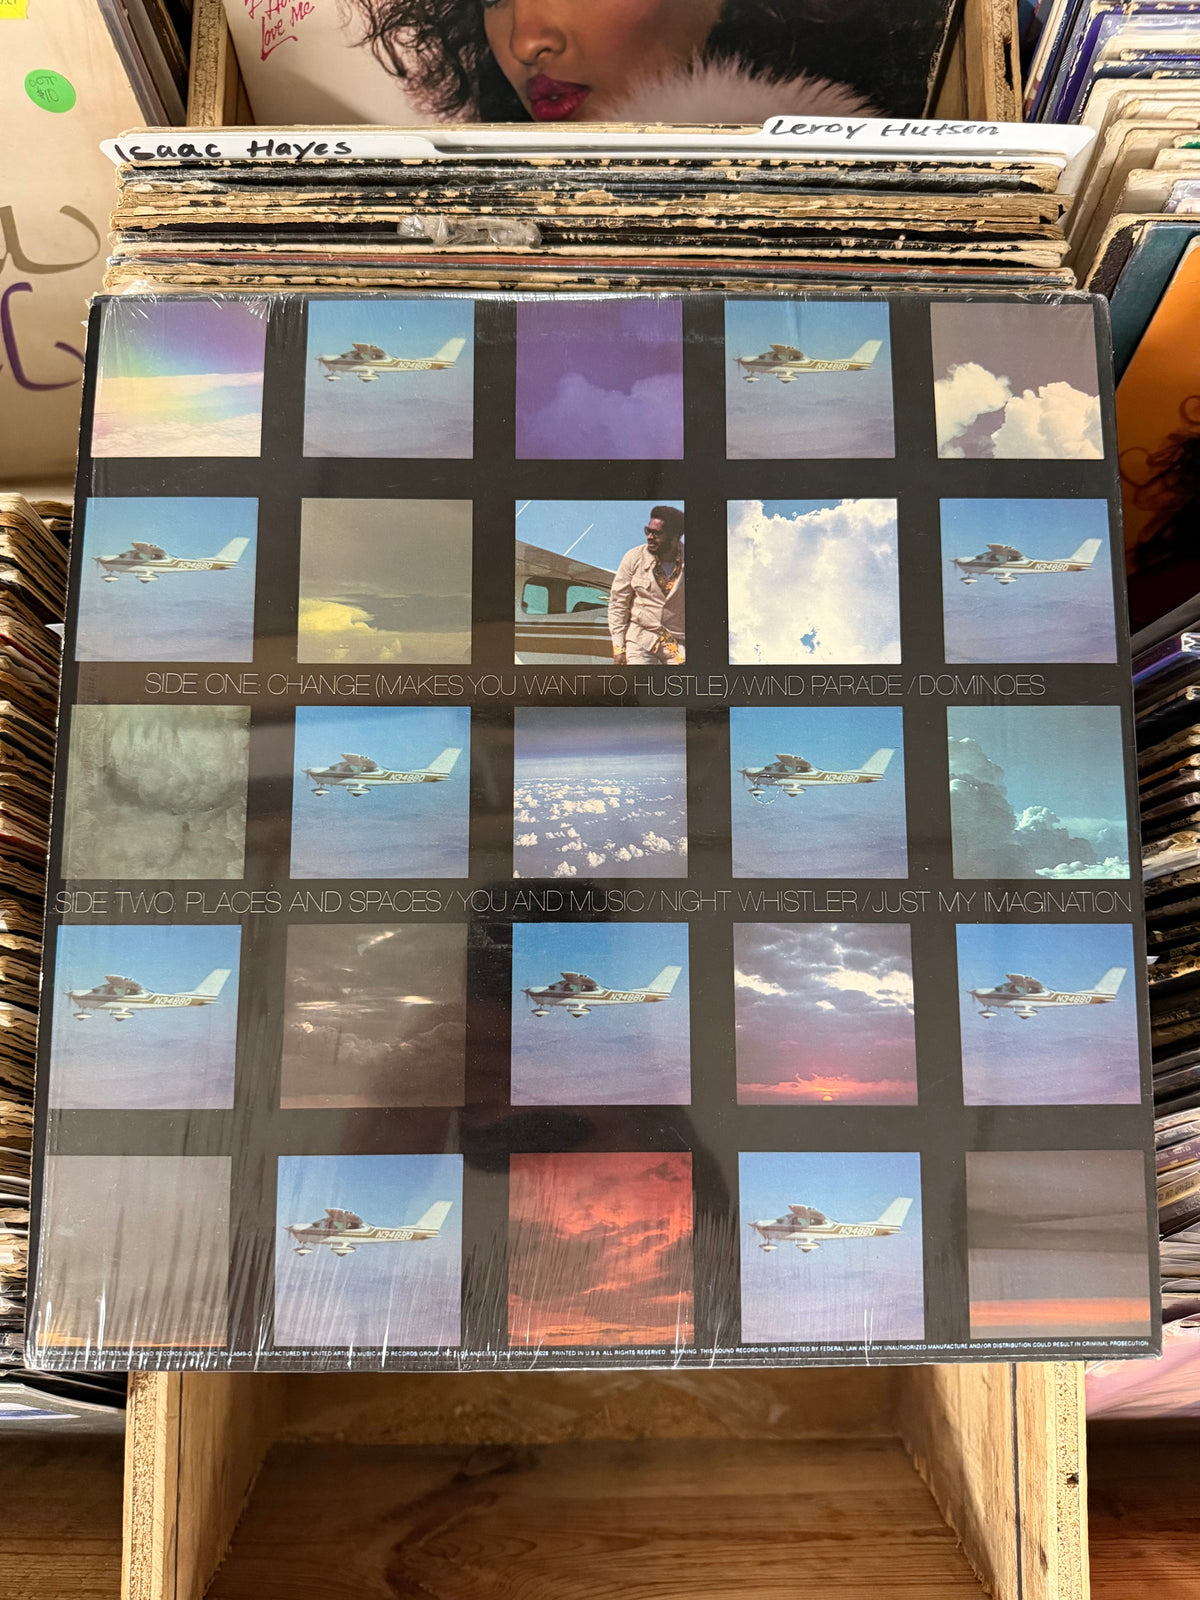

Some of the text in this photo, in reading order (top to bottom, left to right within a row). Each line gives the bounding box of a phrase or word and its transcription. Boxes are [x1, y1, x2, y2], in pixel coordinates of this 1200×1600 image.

[261, 16, 298, 61] Love
[290, 1, 315, 27] Me
[770, 119, 868, 139] Leroy
[115, 139, 352, 162] Isaac Hayes
[145, 672, 198, 695] SIDE
[267, 673, 371, 696] CHANGE
[374, 673, 464, 698] (MAKES
[468, 674, 517, 697] YOU
[523, 674, 591, 696] WANT
[597, 674, 628, 697] TO
[743, 674, 805, 696] WIND
[811, 674, 903, 696] PARADE
[918, 674, 1046, 696] DOMINOES
[55, 890, 108, 914] SIDE
[186, 890, 282, 914] PLACES
[288, 890, 342, 913] AND
[349, 890, 442, 912] SPACES
[456, 889, 507, 912] YOU
[512, 889, 564, 912] AND
[570, 889, 645, 912] MUSIC
[661, 890, 733, 912] NIGHT
[737, 890, 858, 912] WHISTLER
[871, 890, 931, 913] JUST
[938, 891, 976, 912] MY
[984, 890, 1132, 913] IMAGINATION
